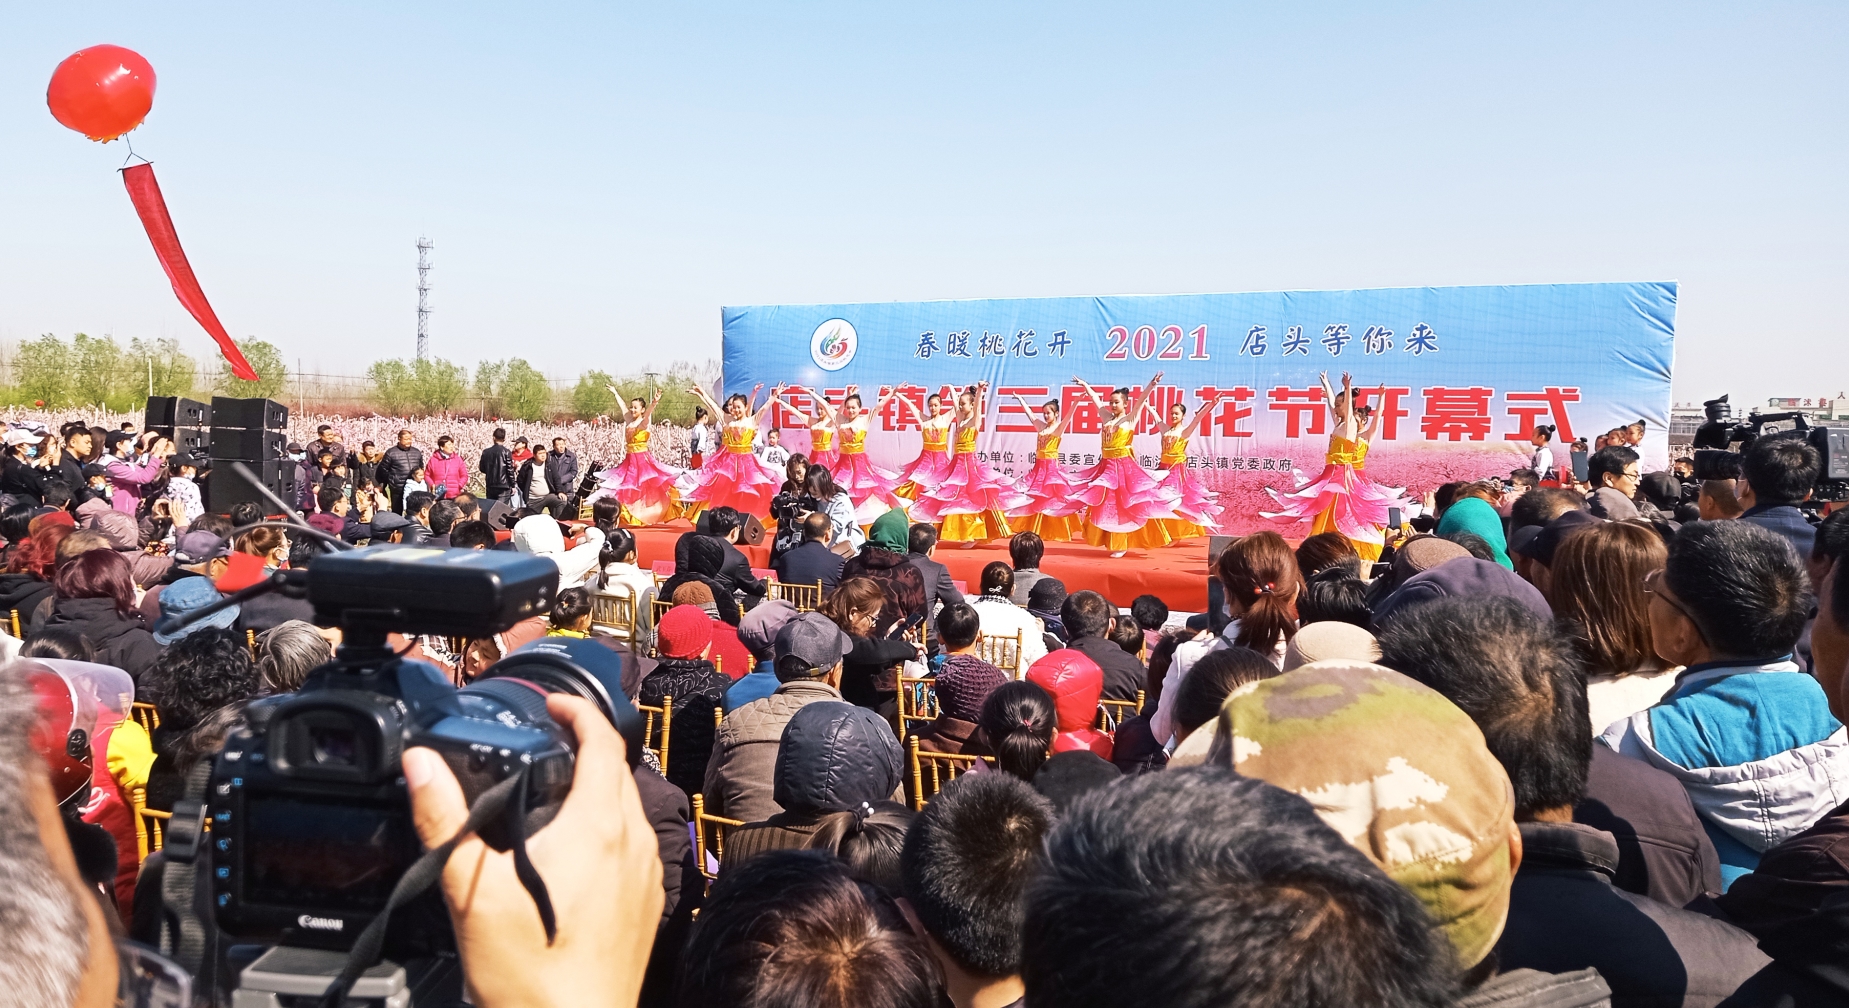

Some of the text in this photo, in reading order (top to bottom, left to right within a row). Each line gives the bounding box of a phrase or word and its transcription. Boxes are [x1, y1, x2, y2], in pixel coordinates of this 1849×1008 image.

[914, 323, 1439, 360] 春暖桃花开 2021 店头等你来
[1139, 454, 1292, 471] 临店头镇党委政府
[297, 914, 344, 931] Canon
